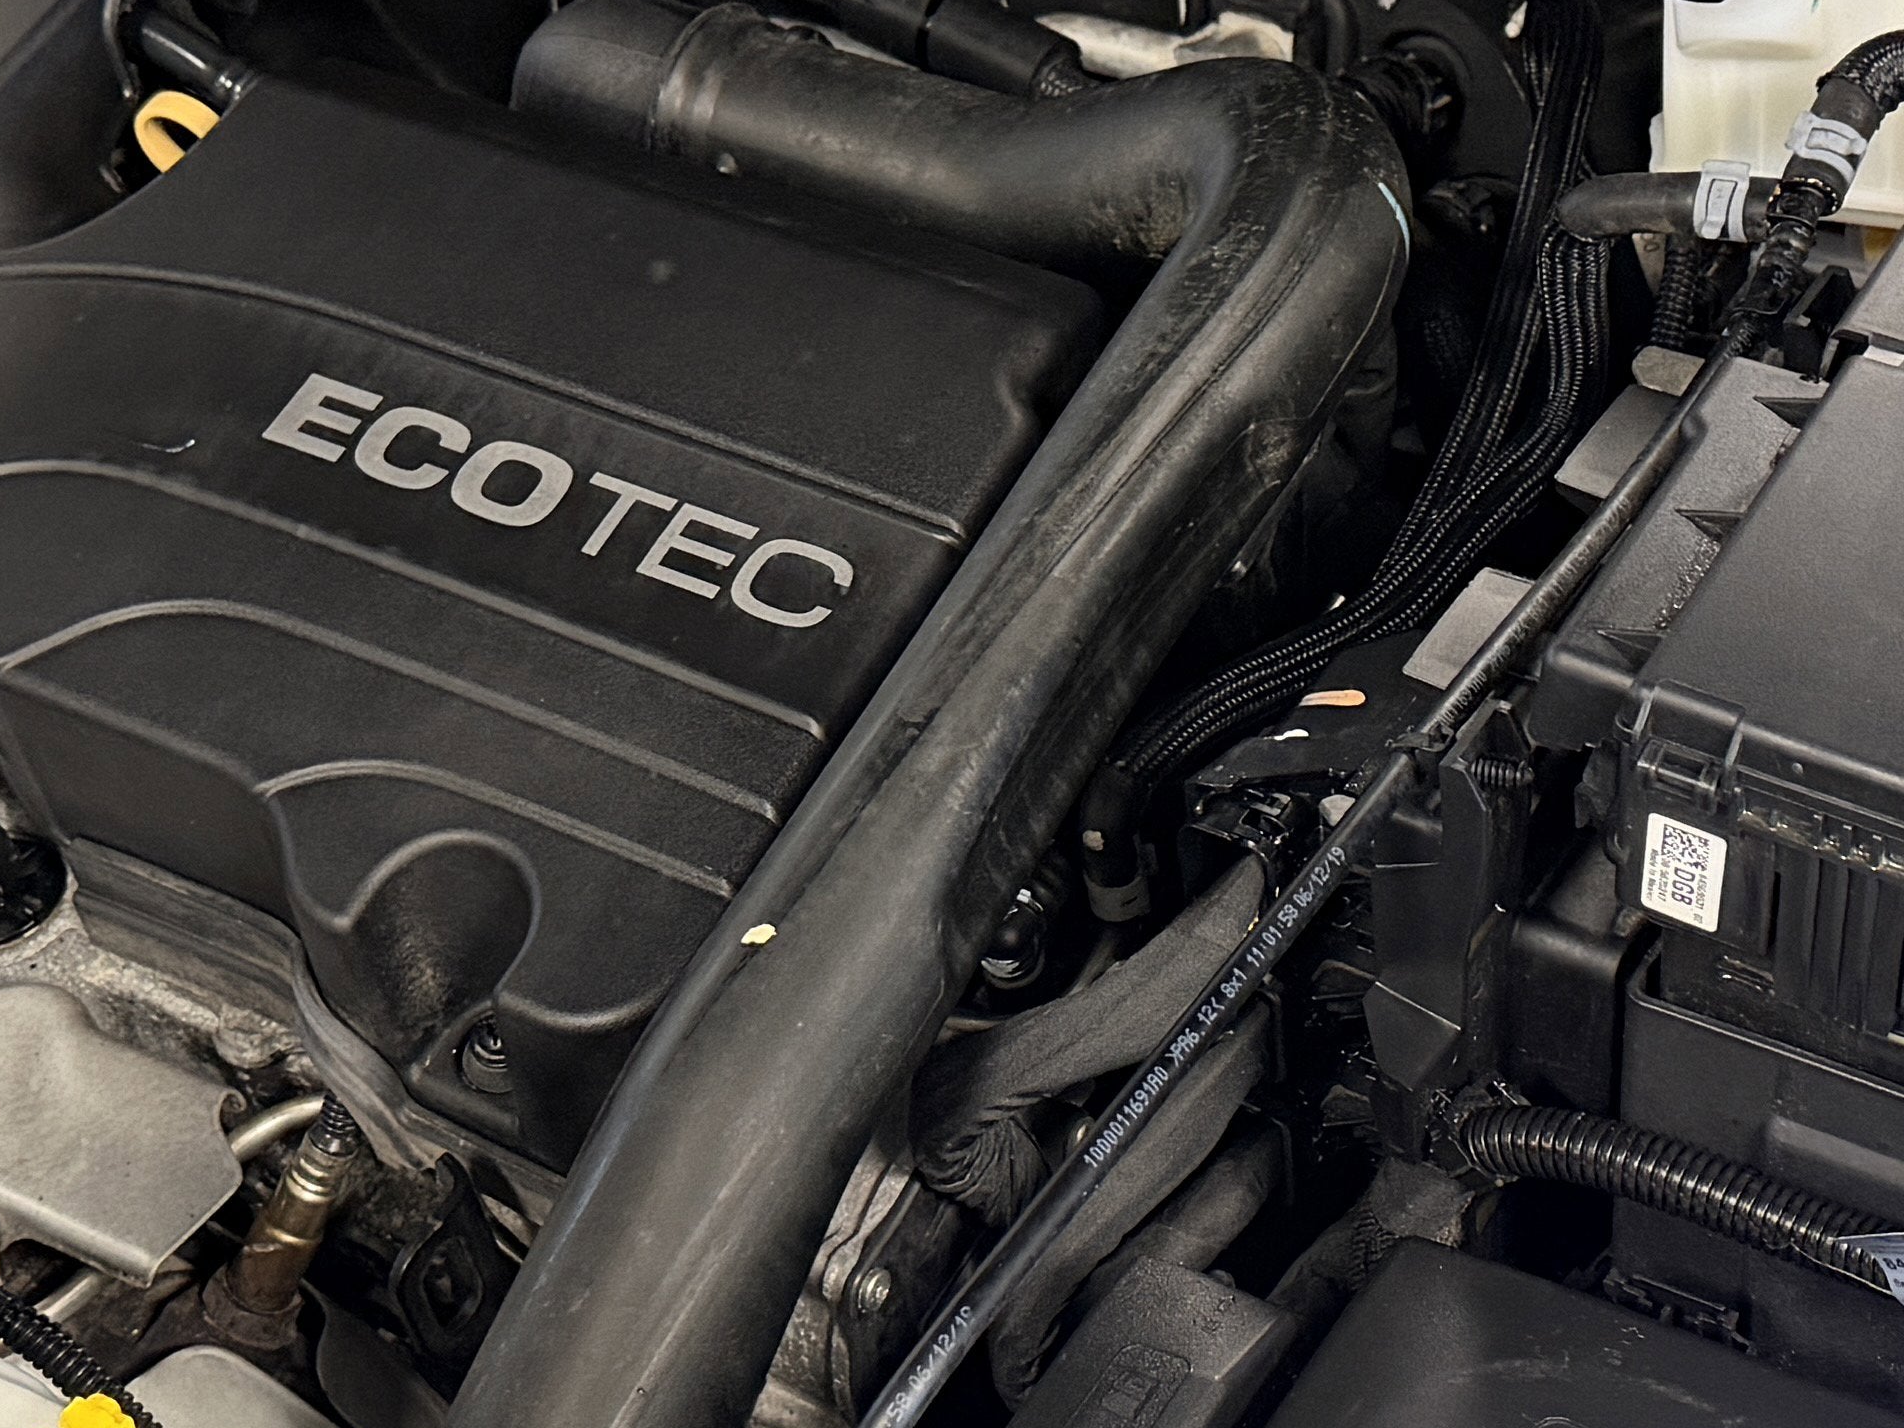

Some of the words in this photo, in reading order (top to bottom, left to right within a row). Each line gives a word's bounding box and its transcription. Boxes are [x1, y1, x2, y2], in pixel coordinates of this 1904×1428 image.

[261, 372, 854, 628] ECOTEC
[1082, 1064, 1170, 1170] 1000011691A0
[1219, 966, 1249, 1000] 8x1
[1295, 845, 1348, 910] 06/12/19
[1671, 865, 1697, 906] DGB
